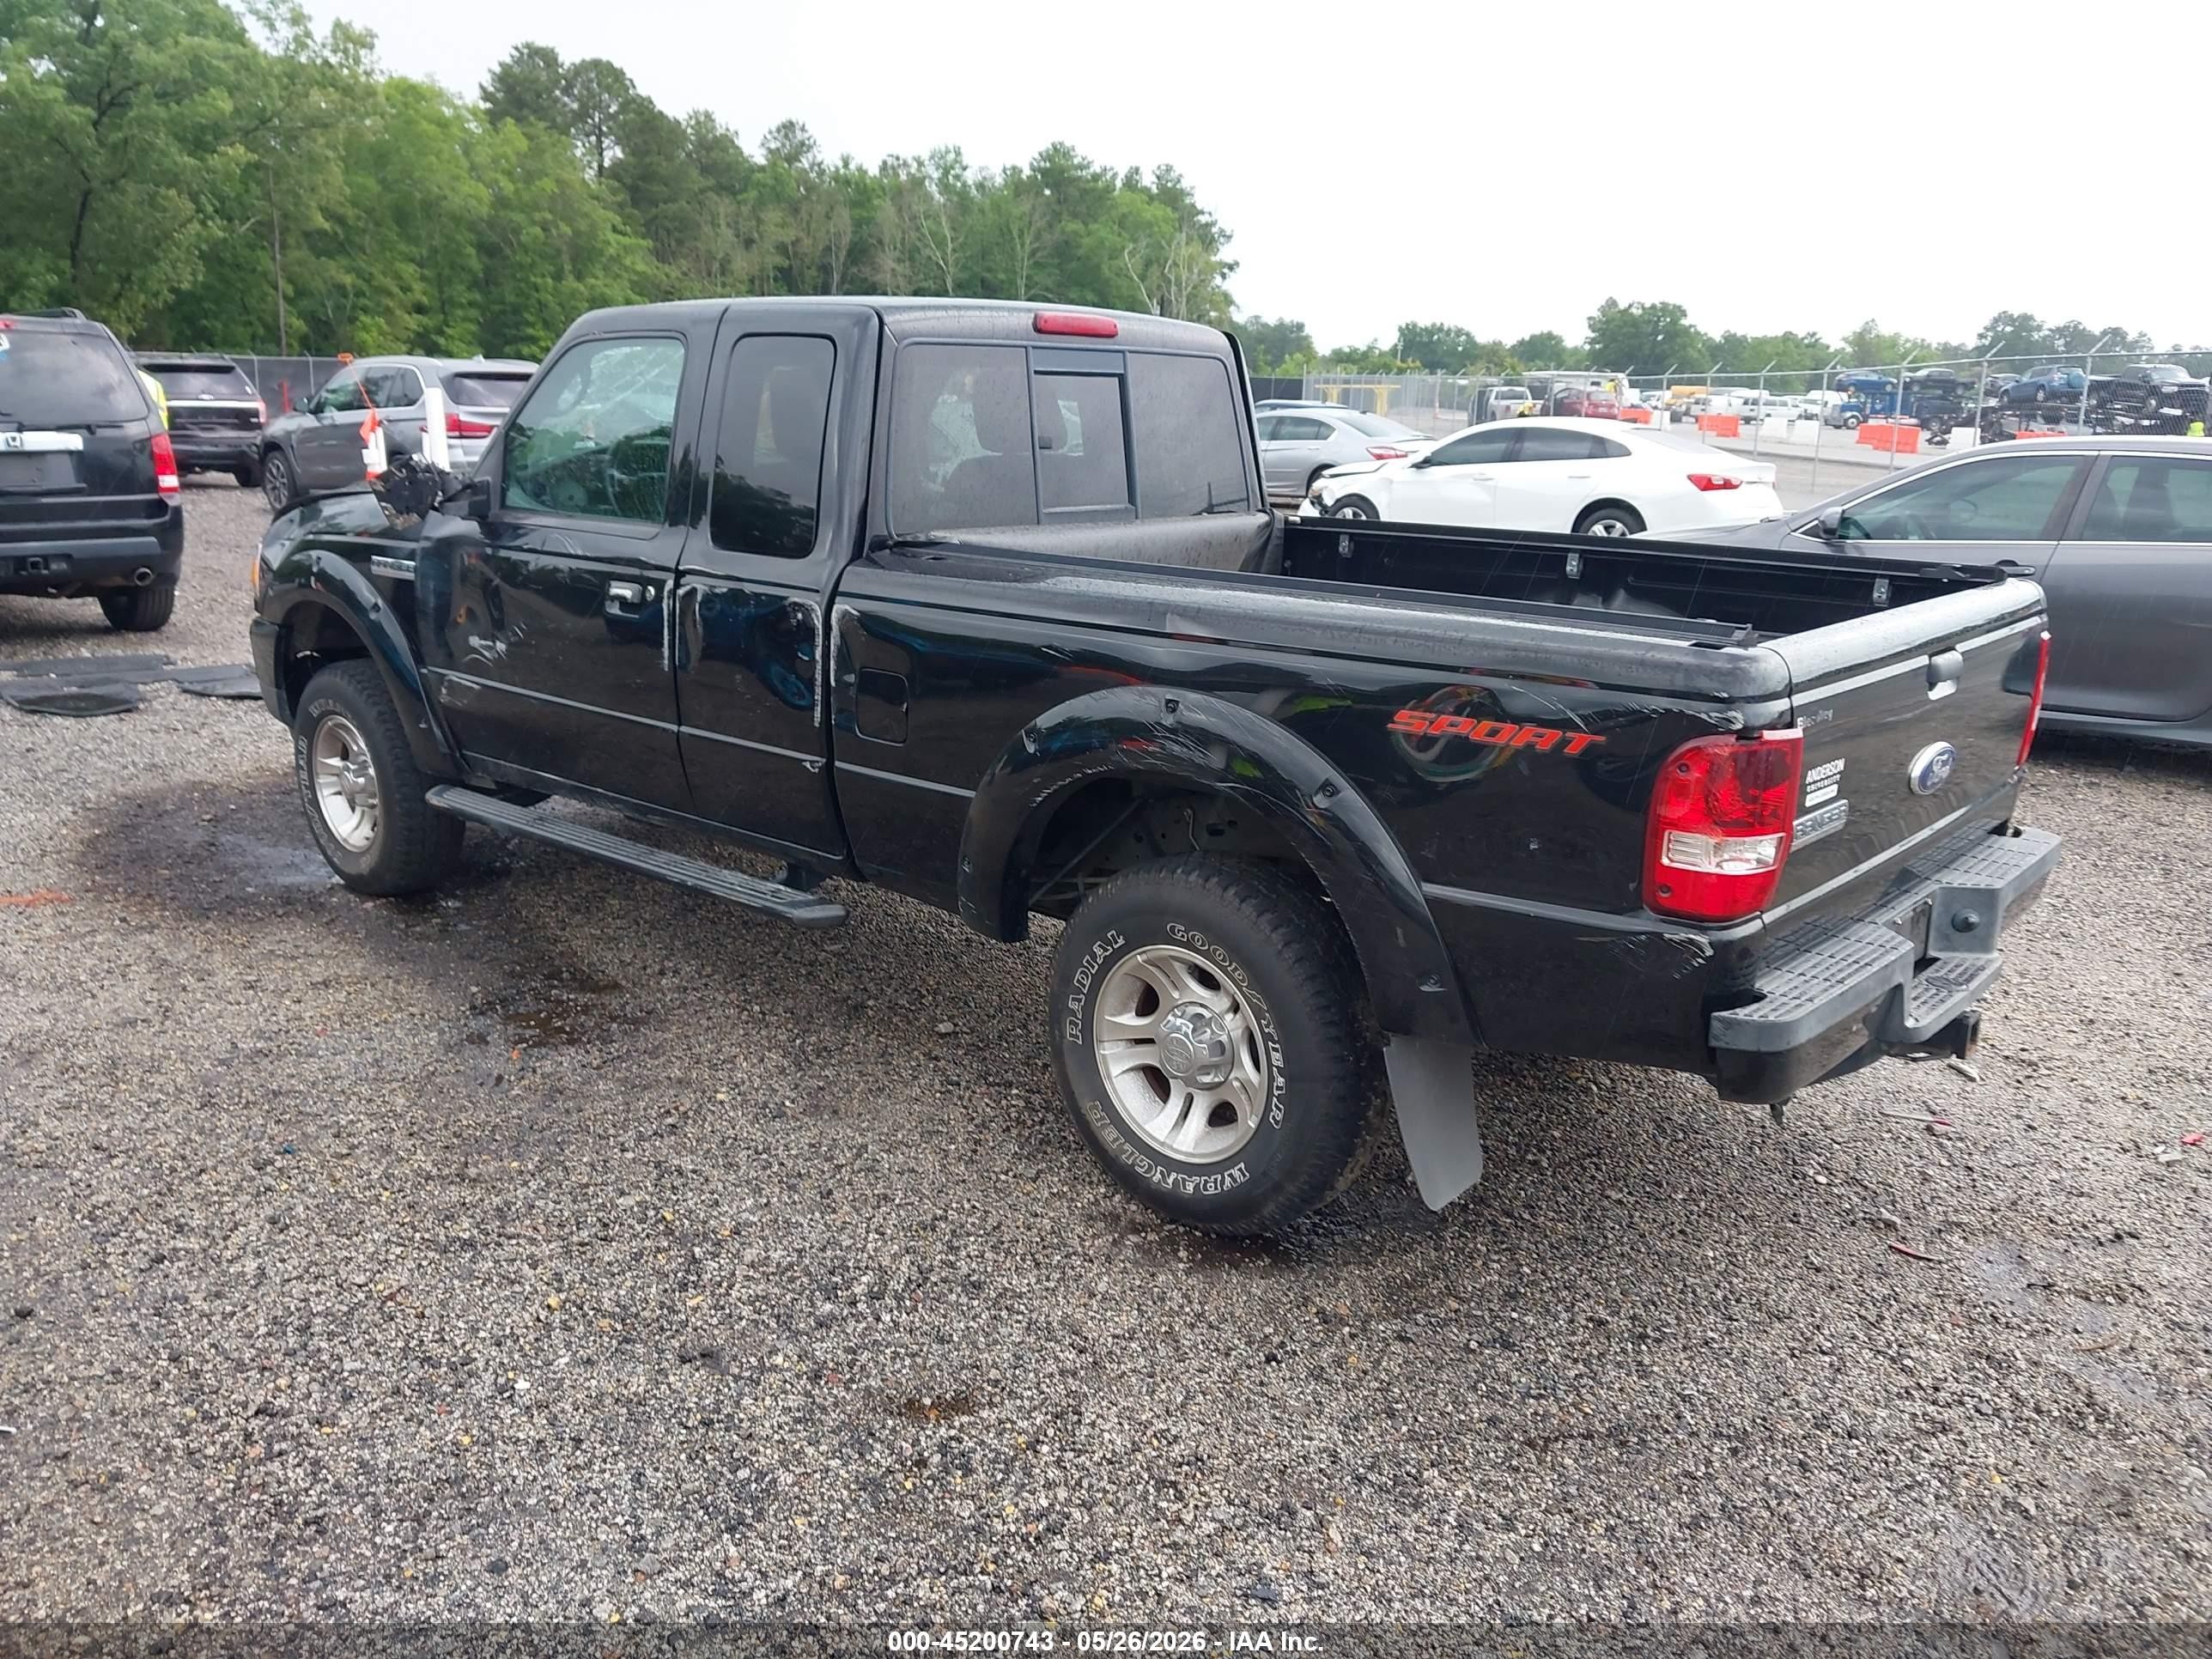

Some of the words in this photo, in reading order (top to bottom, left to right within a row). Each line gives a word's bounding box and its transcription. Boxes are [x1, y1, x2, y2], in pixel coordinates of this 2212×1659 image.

[1387, 710, 1607, 755] SPORT
[1805, 757, 1845, 785] ANDERSON
[1066, 930, 1127, 1045] RADIAL
[1085, 1099, 1251, 1195] WRANGLER
